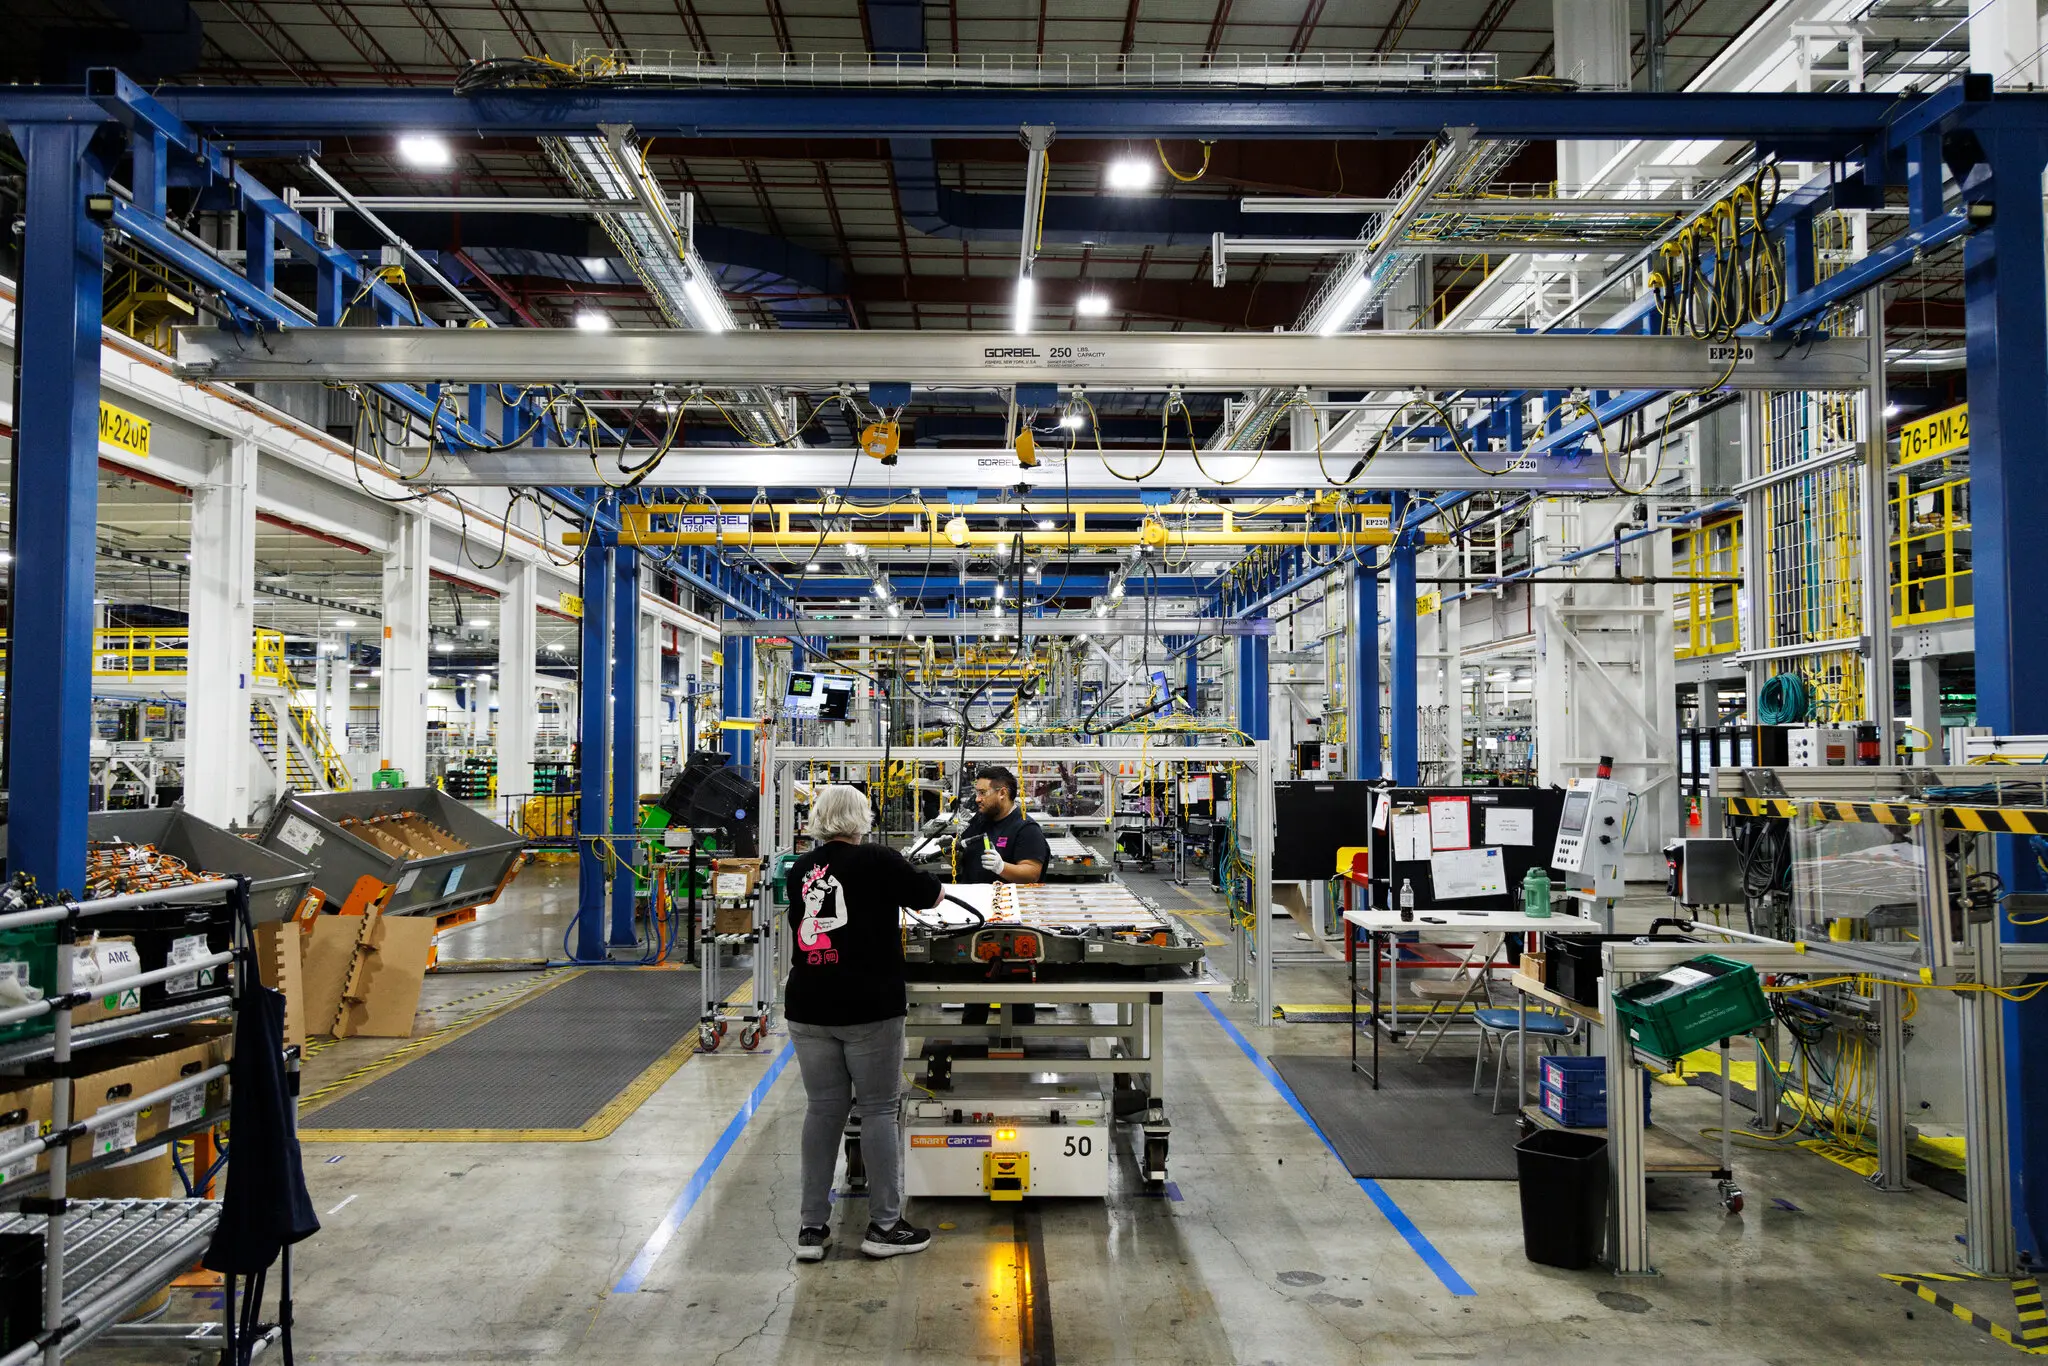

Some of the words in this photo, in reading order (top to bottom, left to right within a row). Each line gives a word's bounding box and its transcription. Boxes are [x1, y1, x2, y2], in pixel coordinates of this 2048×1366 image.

[984, 348, 1040, 358] GORBEL
[1050, 347, 1072, 358] 250
[1709, 347, 1753, 360] EP220
[99, 407, 148, 452] M-220R
[1903, 412, 1969, 457] 76-PM-2
[978, 458, 1018, 467] GORBEL
[682, 515, 748, 525] GORBEL
[684, 524, 704, 532] 1750
[108, 950, 131, 964] AME
[1063, 1135, 1092, 1157] 50
